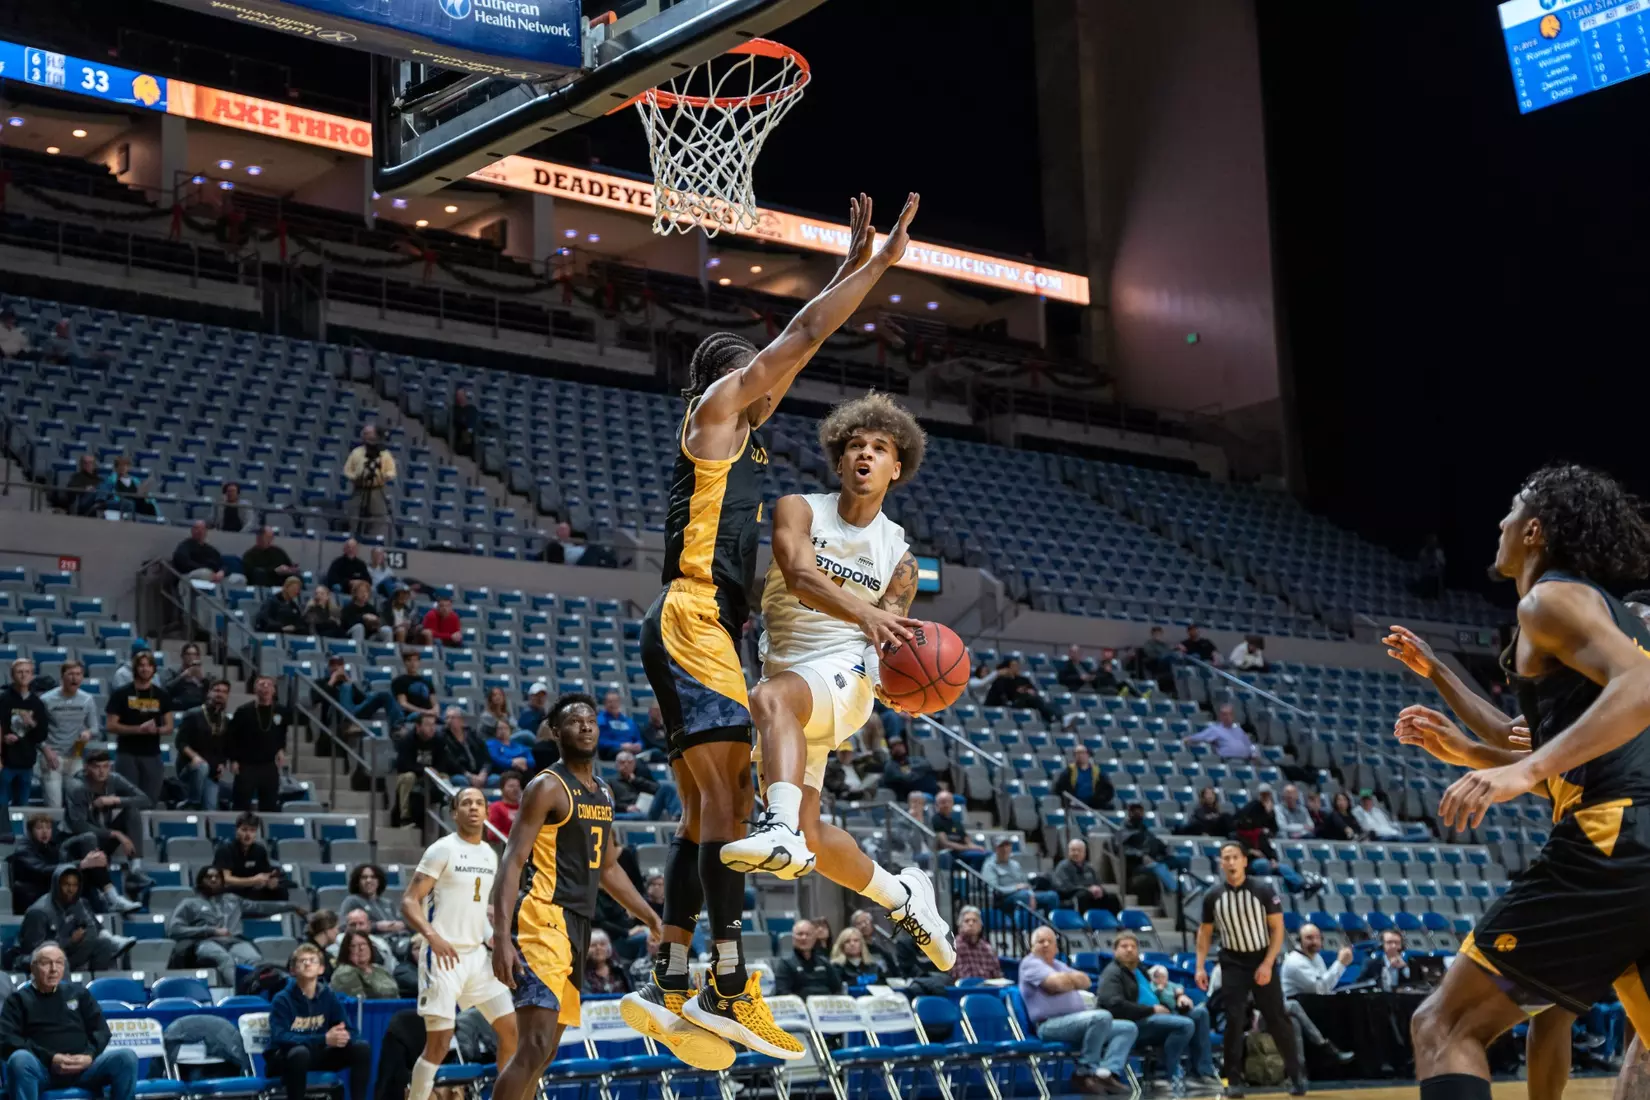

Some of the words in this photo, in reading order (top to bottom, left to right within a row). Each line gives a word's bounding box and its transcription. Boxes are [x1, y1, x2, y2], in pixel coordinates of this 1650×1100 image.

[474, 0, 540, 16] Lutheran
[1566, 4, 1593, 20] TEAM
[474, 10, 516, 28] Health
[518, 18, 572, 37] Network
[1592, 52, 1602, 61] 10
[1594, 63, 1606, 72] 10
[32, 52, 41, 66] 6
[81, 67, 110, 92] 33
[32, 68, 41, 80] 3
[212, 98, 279, 129] AXE
[285, 112, 370, 148] THRO
[533, 167, 652, 208] DEADEYE
[577, 804, 614, 822] COMMERCE
[589, 826, 604, 869] 3
[472, 876, 482, 902] 1
